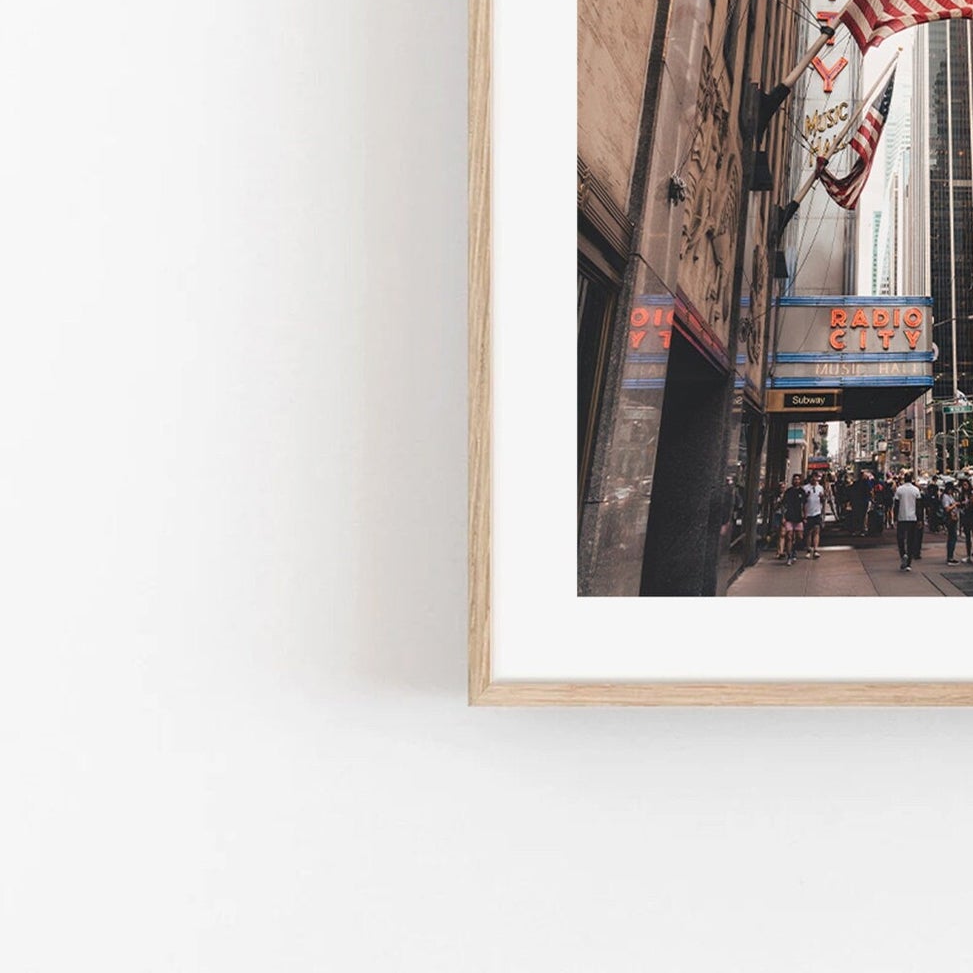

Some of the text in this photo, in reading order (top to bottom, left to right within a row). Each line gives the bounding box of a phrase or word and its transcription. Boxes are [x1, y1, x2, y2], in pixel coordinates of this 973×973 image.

[805, 101, 849, 138] MUSIC
[830, 307, 923, 328] RADIO
[829, 329, 922, 350] CITY
[815, 362, 865, 376] MUSIC
[792, 395, 826, 405] Subway
